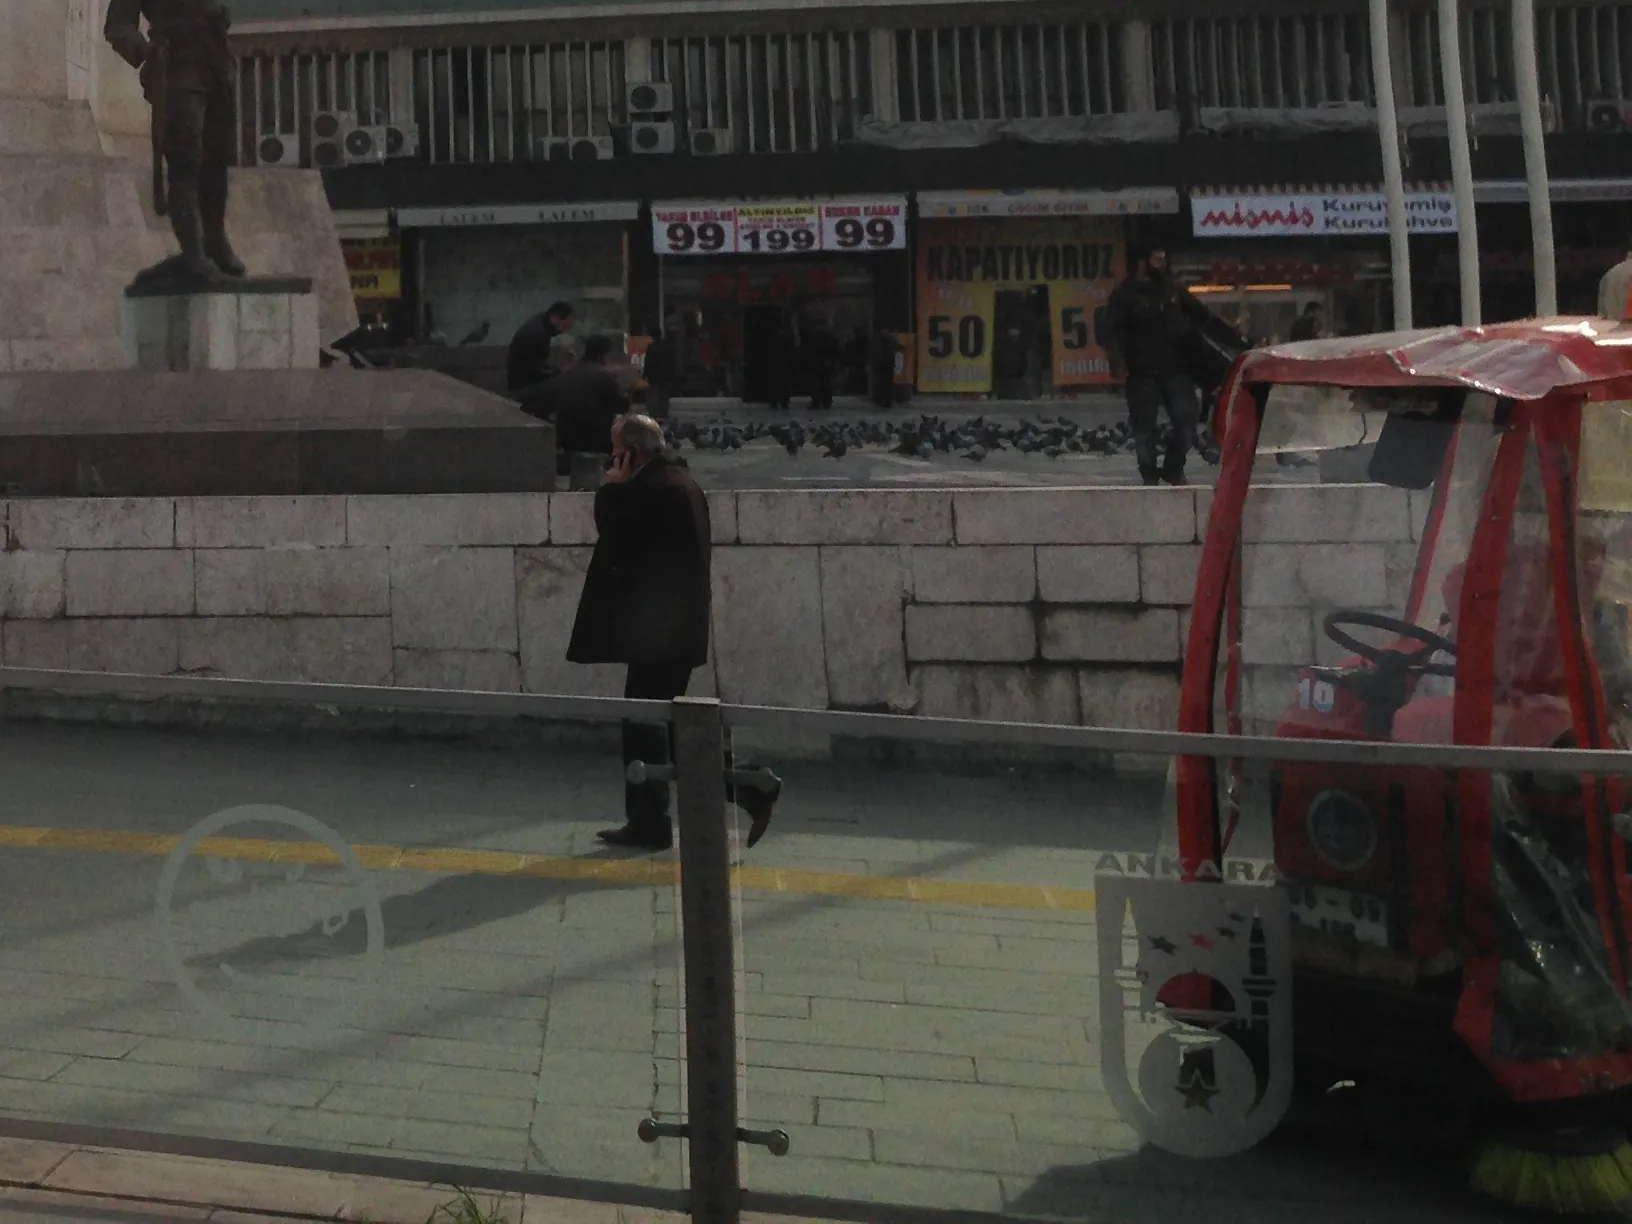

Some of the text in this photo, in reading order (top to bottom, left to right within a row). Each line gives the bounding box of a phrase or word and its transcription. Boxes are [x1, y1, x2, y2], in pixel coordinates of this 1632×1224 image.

[666, 222, 726, 252] 99
[741, 228, 816, 252] 199
[834, 218, 896, 249] 99
[927, 315, 985, 359] 50
[1095, 851, 1284, 883] ANKARA
